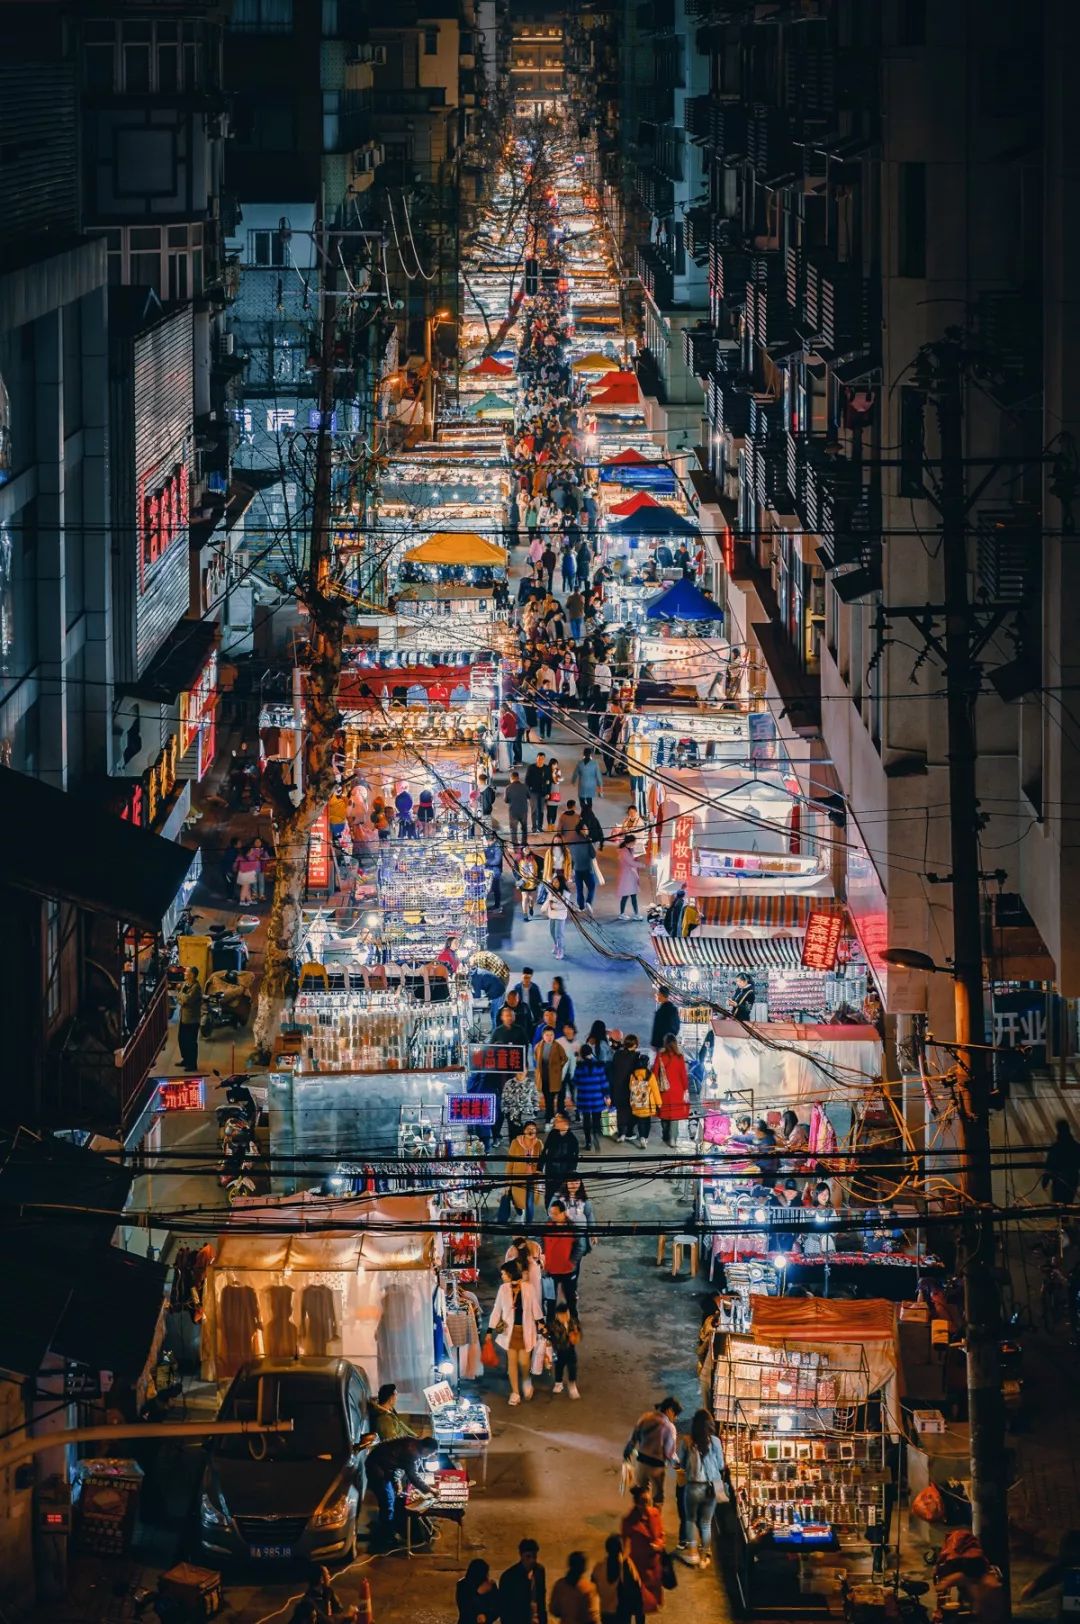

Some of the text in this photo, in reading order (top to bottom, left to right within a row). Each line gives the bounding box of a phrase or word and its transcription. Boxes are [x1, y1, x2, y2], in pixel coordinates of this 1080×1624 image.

[674, 819, 690, 880] 化妆品
[994, 1010, 1047, 1047] 开业
